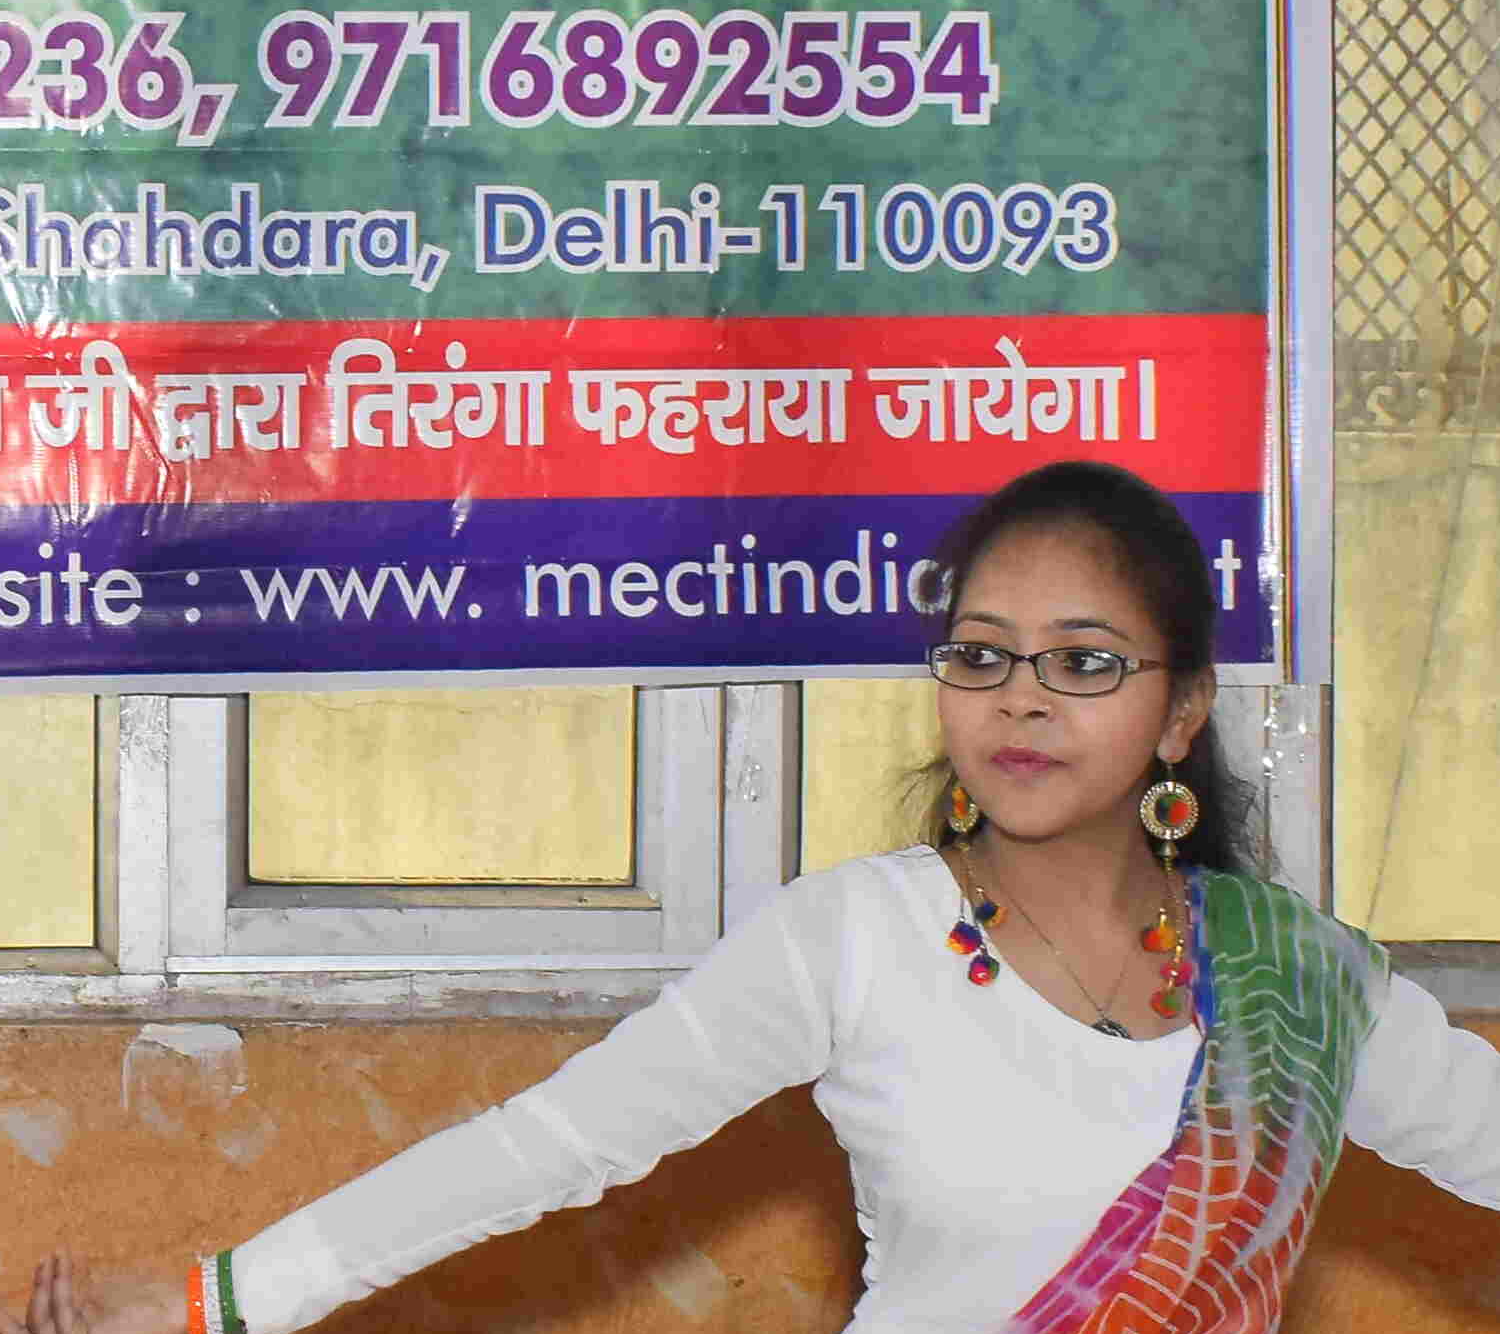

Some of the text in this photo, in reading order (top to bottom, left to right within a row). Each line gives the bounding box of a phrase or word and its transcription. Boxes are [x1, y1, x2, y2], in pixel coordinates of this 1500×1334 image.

[266, 17, 994, 127] 9716892554
[480, 185, 1116, 273] Delhi-110093
[24, 340, 136, 451] जी
[152, 373, 307, 462] द्वारा
[324, 341, 552, 451] तिरंगा
[568, 369, 852, 454] फहराया
[239, 567, 482, 623] www.
